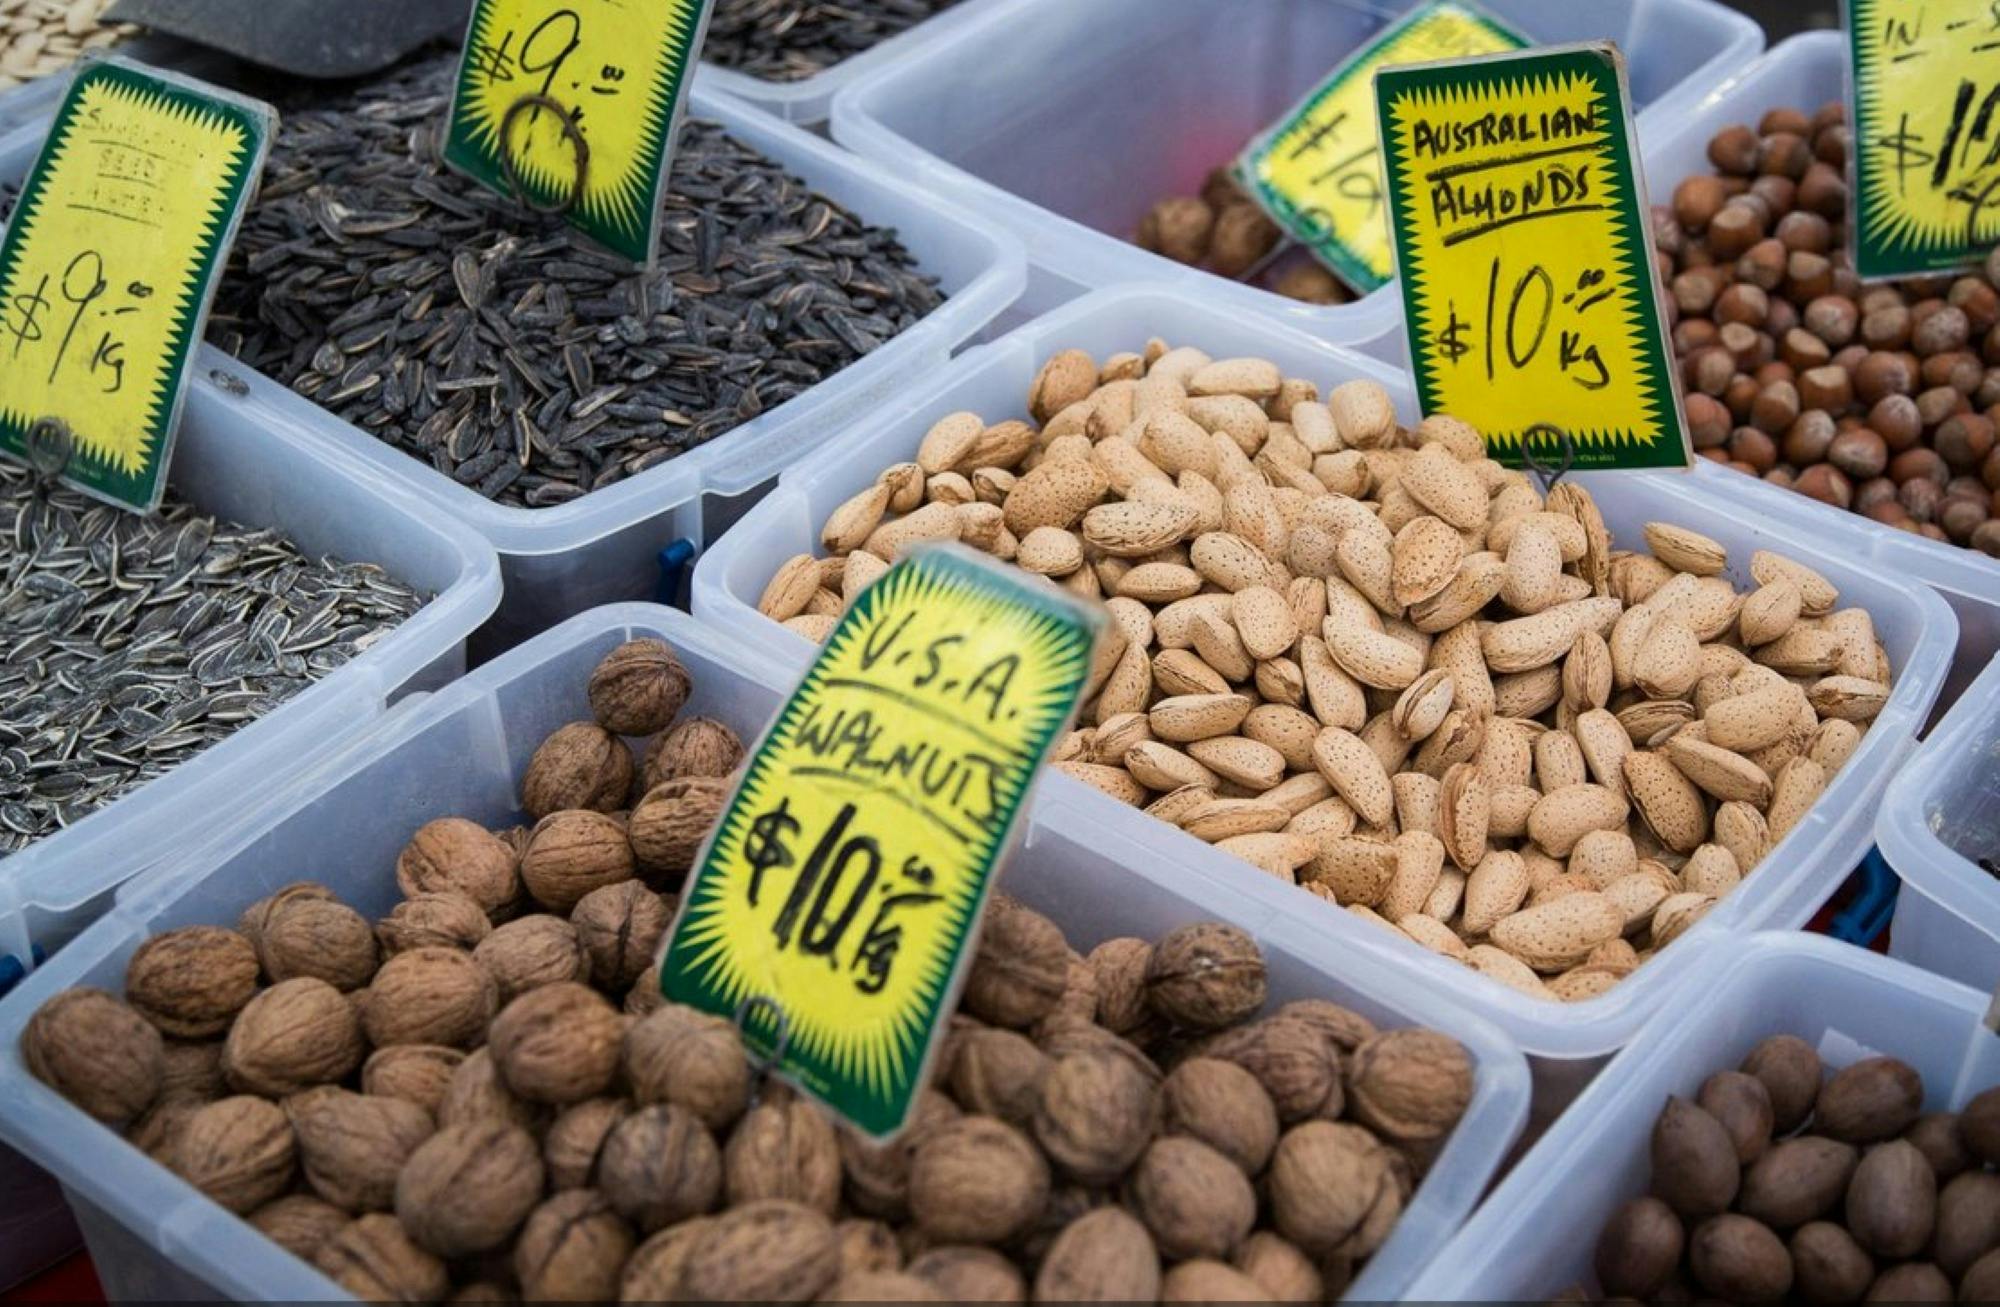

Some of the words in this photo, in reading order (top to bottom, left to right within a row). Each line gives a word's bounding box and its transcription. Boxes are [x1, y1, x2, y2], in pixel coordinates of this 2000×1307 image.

[1413, 105, 1595, 160] AUSTRALIAN
[1431, 164, 1590, 228] ALMONDS
[1437, 256, 1607, 384] $10.00
[861, 610, 1020, 721] U.S.A.
[794, 703, 1006, 834] WALNUTS
